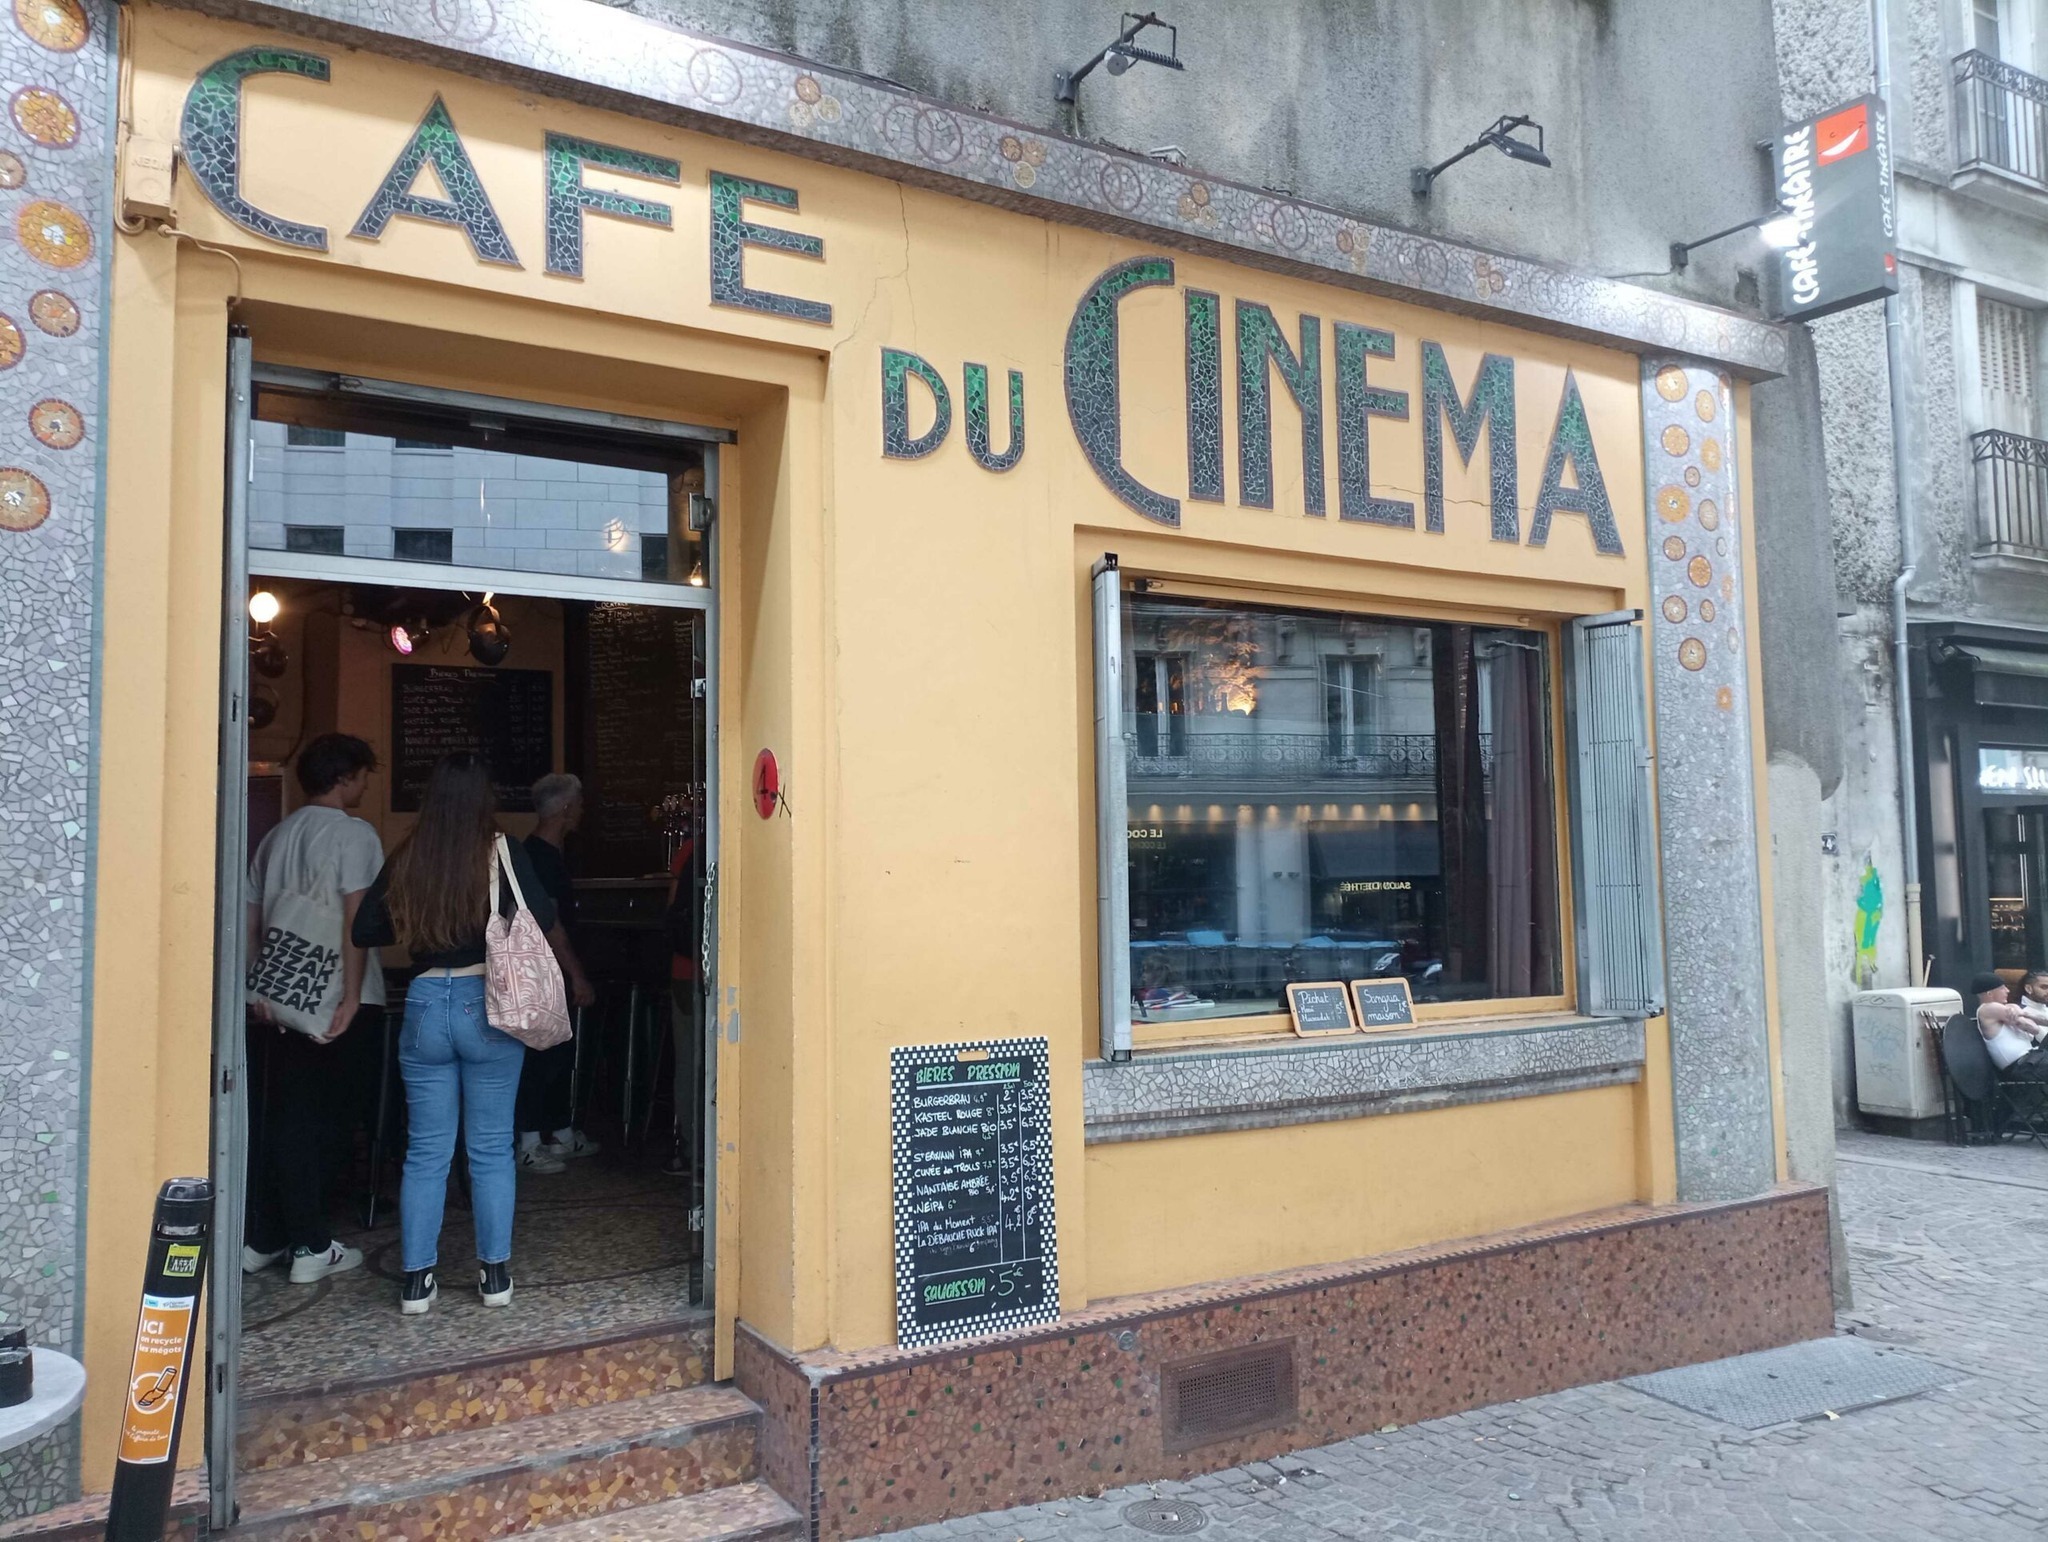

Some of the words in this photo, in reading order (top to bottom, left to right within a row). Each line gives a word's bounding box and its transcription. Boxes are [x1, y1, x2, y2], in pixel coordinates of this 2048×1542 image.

[179, 45, 833, 326] CAFE
[881, 346, 1026, 473] DU
[1064, 255, 1625, 557] CINEMA
[1368, 1012, 1401, 1020] maison
[914, 1111, 952, 1124] KASTEEL
[914, 1127, 938, 1138] JADE
[942, 1124, 978, 1136] BLANCHE
[142, 1320, 165, 1334] ICI
[151, 1336, 182, 1346] recycle
[139, 1344, 148, 1352] les
[150, 1346, 182, 1356] mégots
